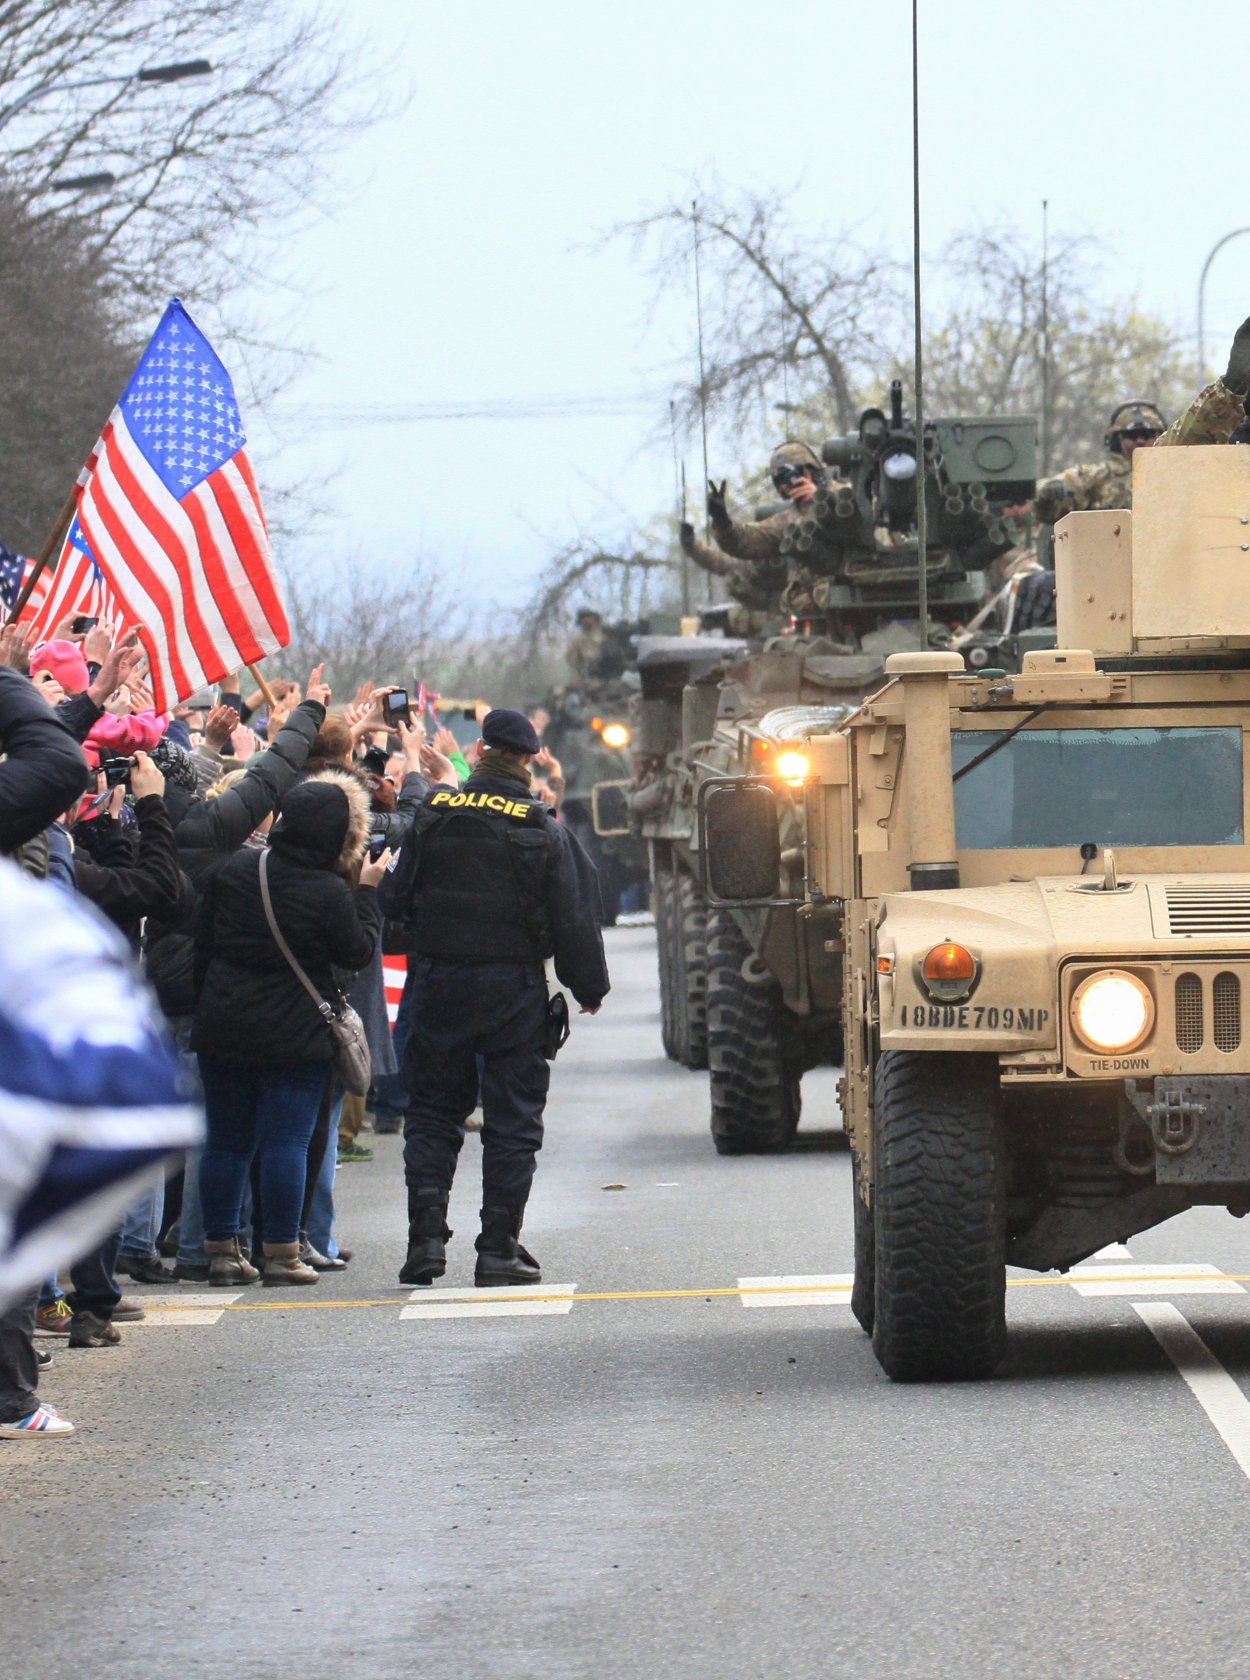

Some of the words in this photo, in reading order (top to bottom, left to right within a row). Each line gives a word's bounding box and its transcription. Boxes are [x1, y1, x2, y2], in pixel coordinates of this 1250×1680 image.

[431, 792, 531, 818] POLICIE
[901, 1005, 1049, 1031] 18BDE709MP
[1089, 1059, 1150, 1071] TIE-DOWN
